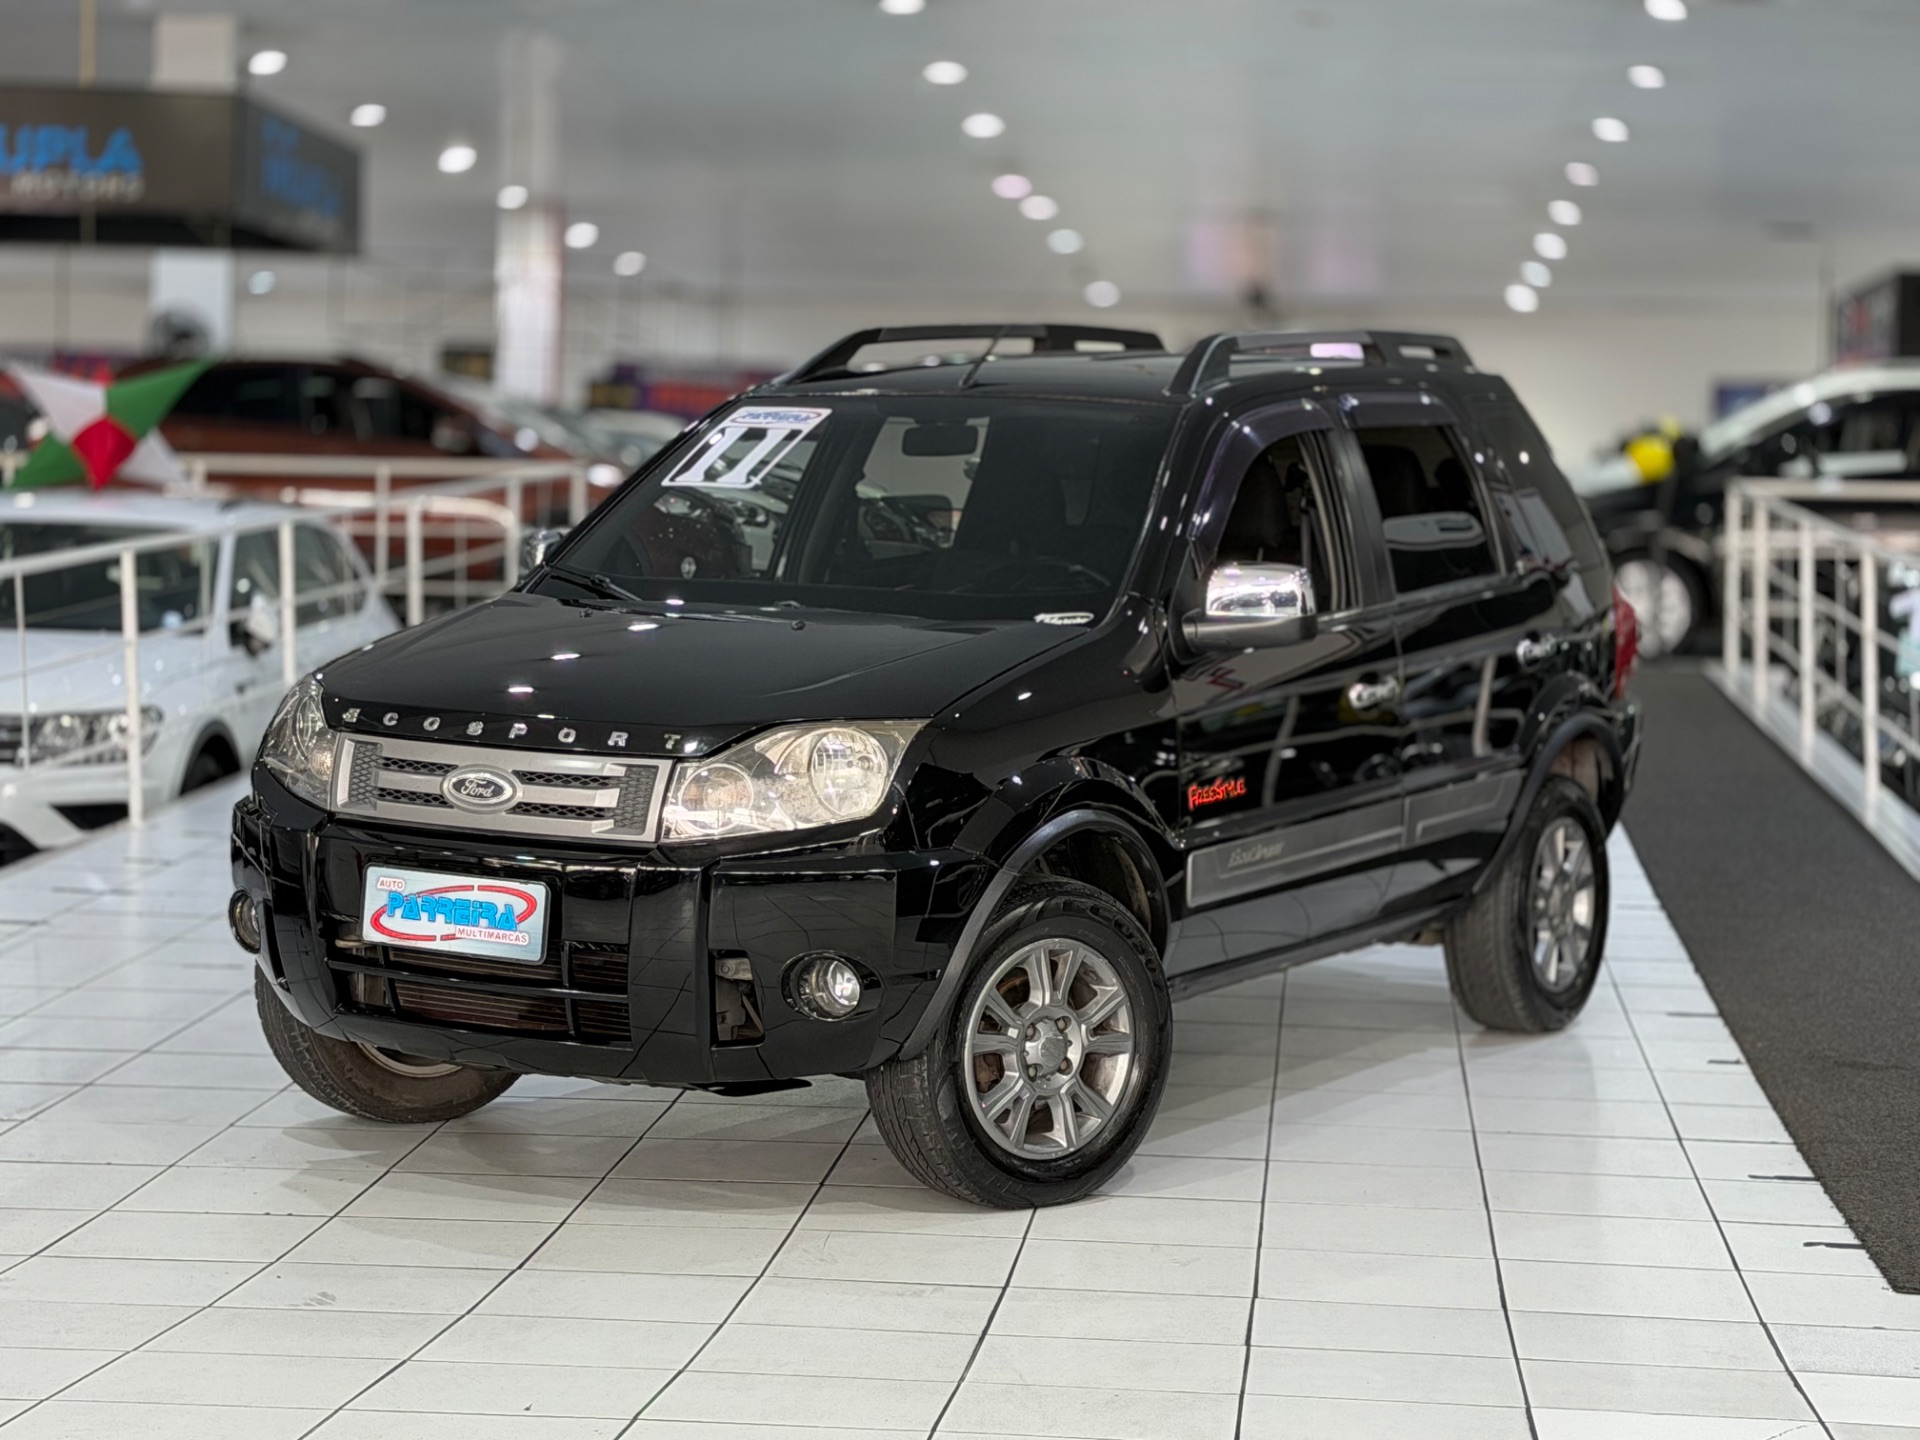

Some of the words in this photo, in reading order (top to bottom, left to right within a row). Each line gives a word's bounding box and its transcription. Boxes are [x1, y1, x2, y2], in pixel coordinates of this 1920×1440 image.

[342, 707, 681, 750] ECOSPORT
[460, 779, 495, 800] Ford
[379, 879, 404, 889] AUTO
[387, 892, 517, 931] PARREIRA
[457, 928, 528, 943] MULTIMARCAS
